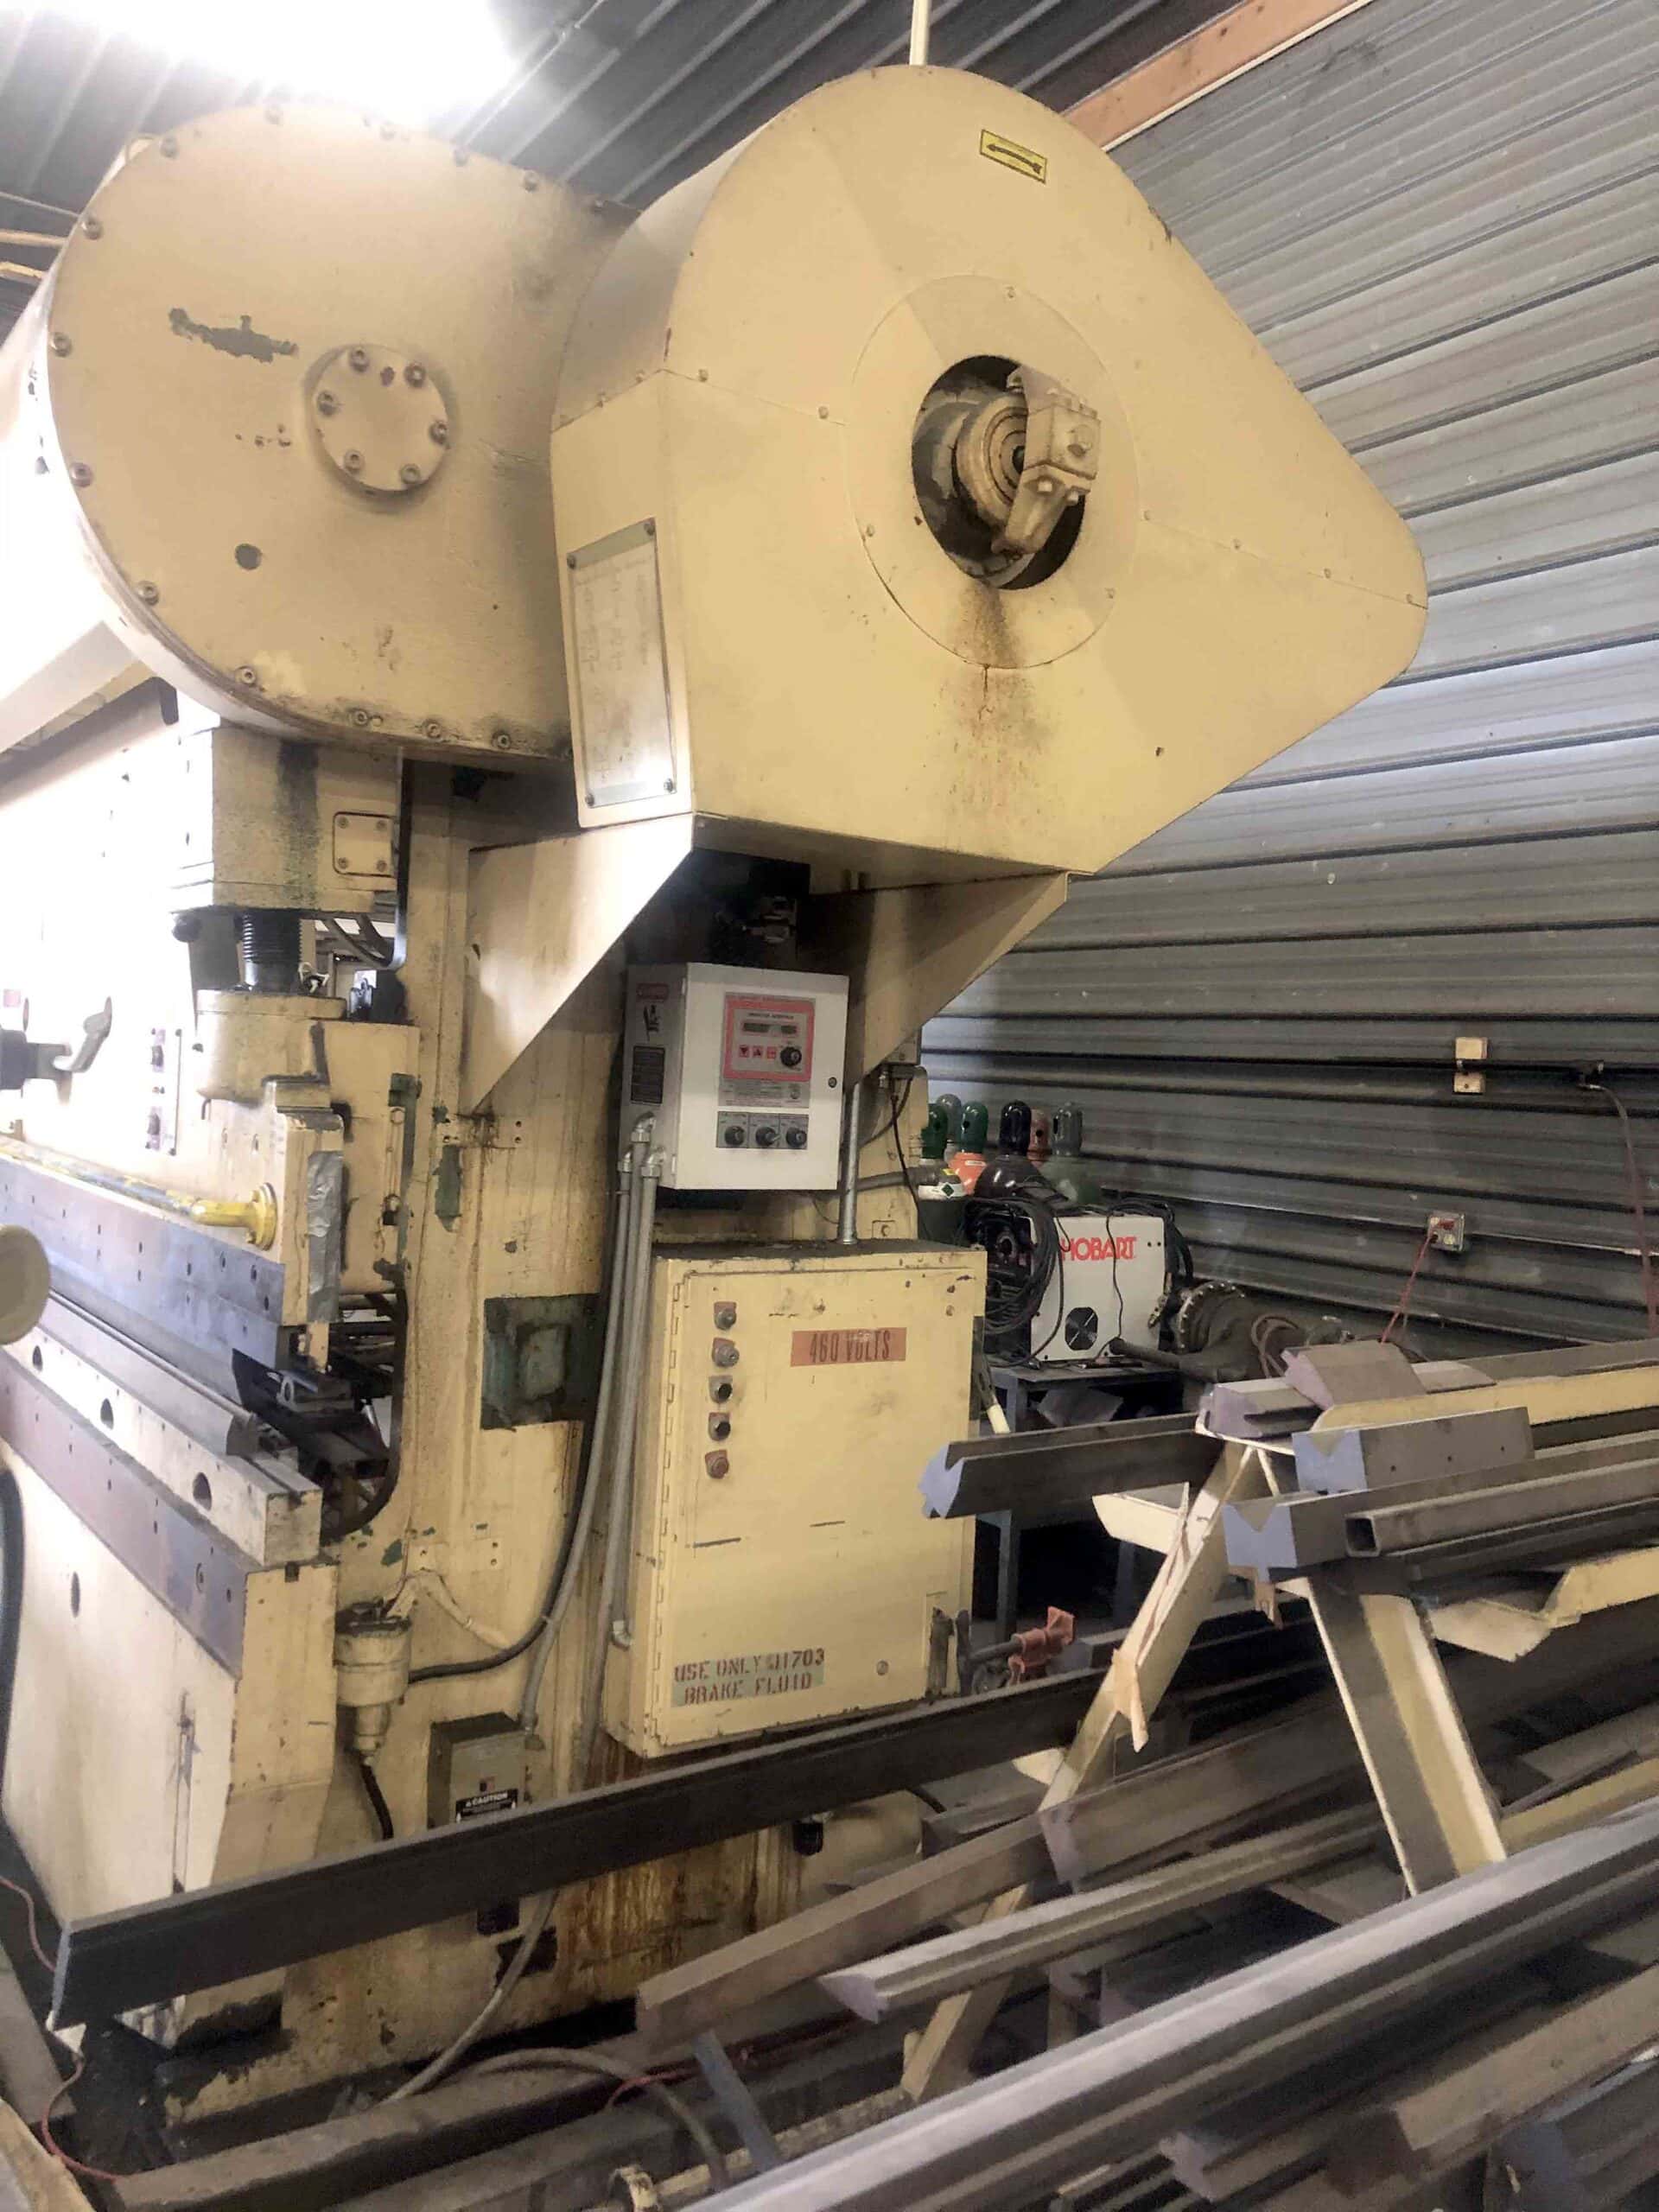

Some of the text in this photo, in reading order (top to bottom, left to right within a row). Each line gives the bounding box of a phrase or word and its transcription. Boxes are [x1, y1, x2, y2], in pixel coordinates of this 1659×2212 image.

[1061, 1236, 1137, 1261] HOBART
[810, 1330, 891, 1363] 460 VOLTS
[674, 1661, 709, 1682] USE
[716, 1656, 761, 1676] ONLY
[684, 1673, 812, 1704] BRAKE FLUID
[472, 1791, 508, 1806] CAUTION
